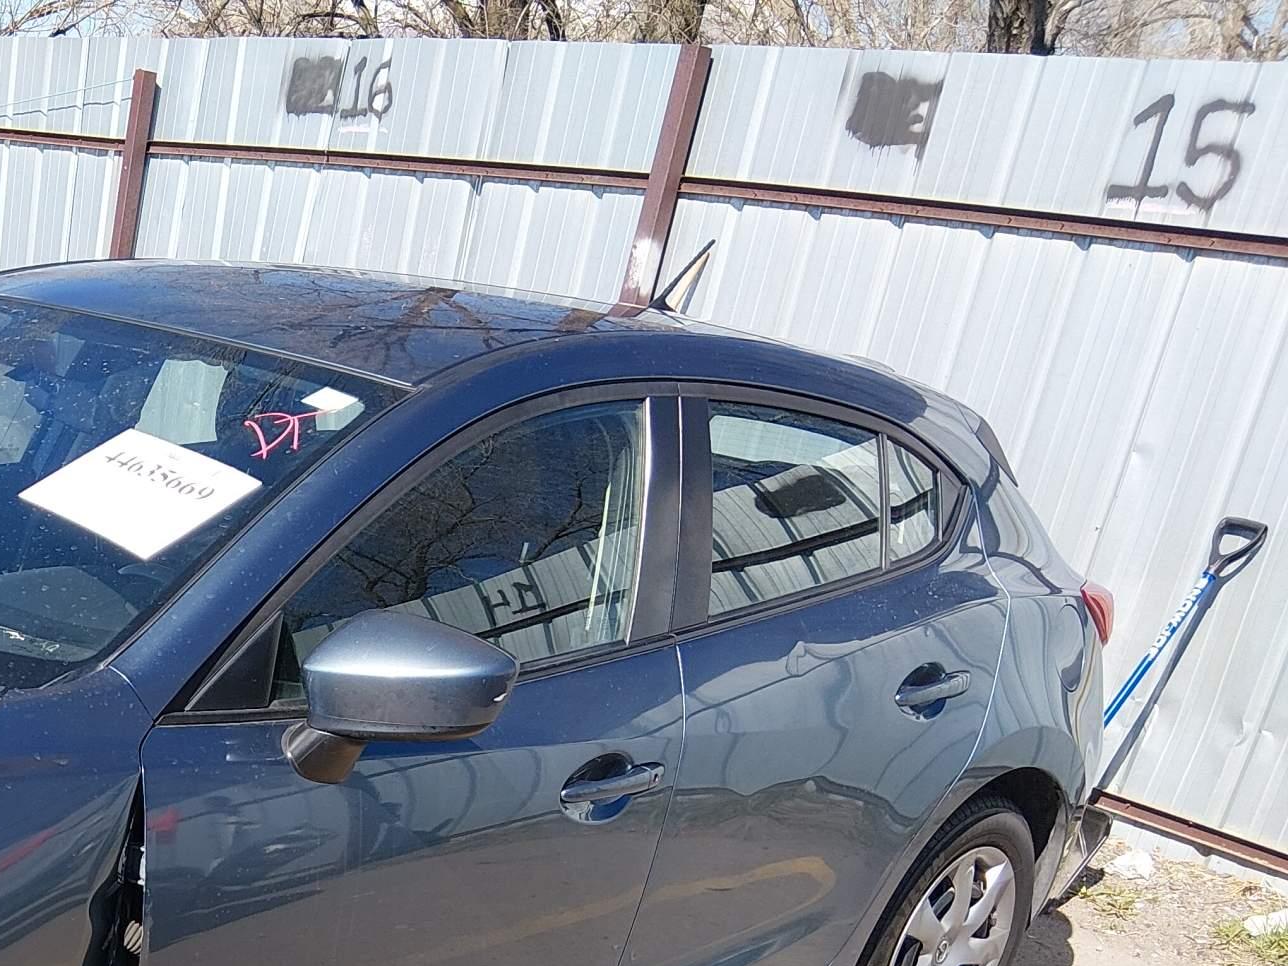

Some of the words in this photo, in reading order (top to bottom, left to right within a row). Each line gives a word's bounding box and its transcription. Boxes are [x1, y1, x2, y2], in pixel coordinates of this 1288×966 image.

[339, 56, 393, 120] 16
[1106, 93, 1257, 209] 15
[244, 411, 339, 460] DT
[105, 450, 216, 500] 44635669
